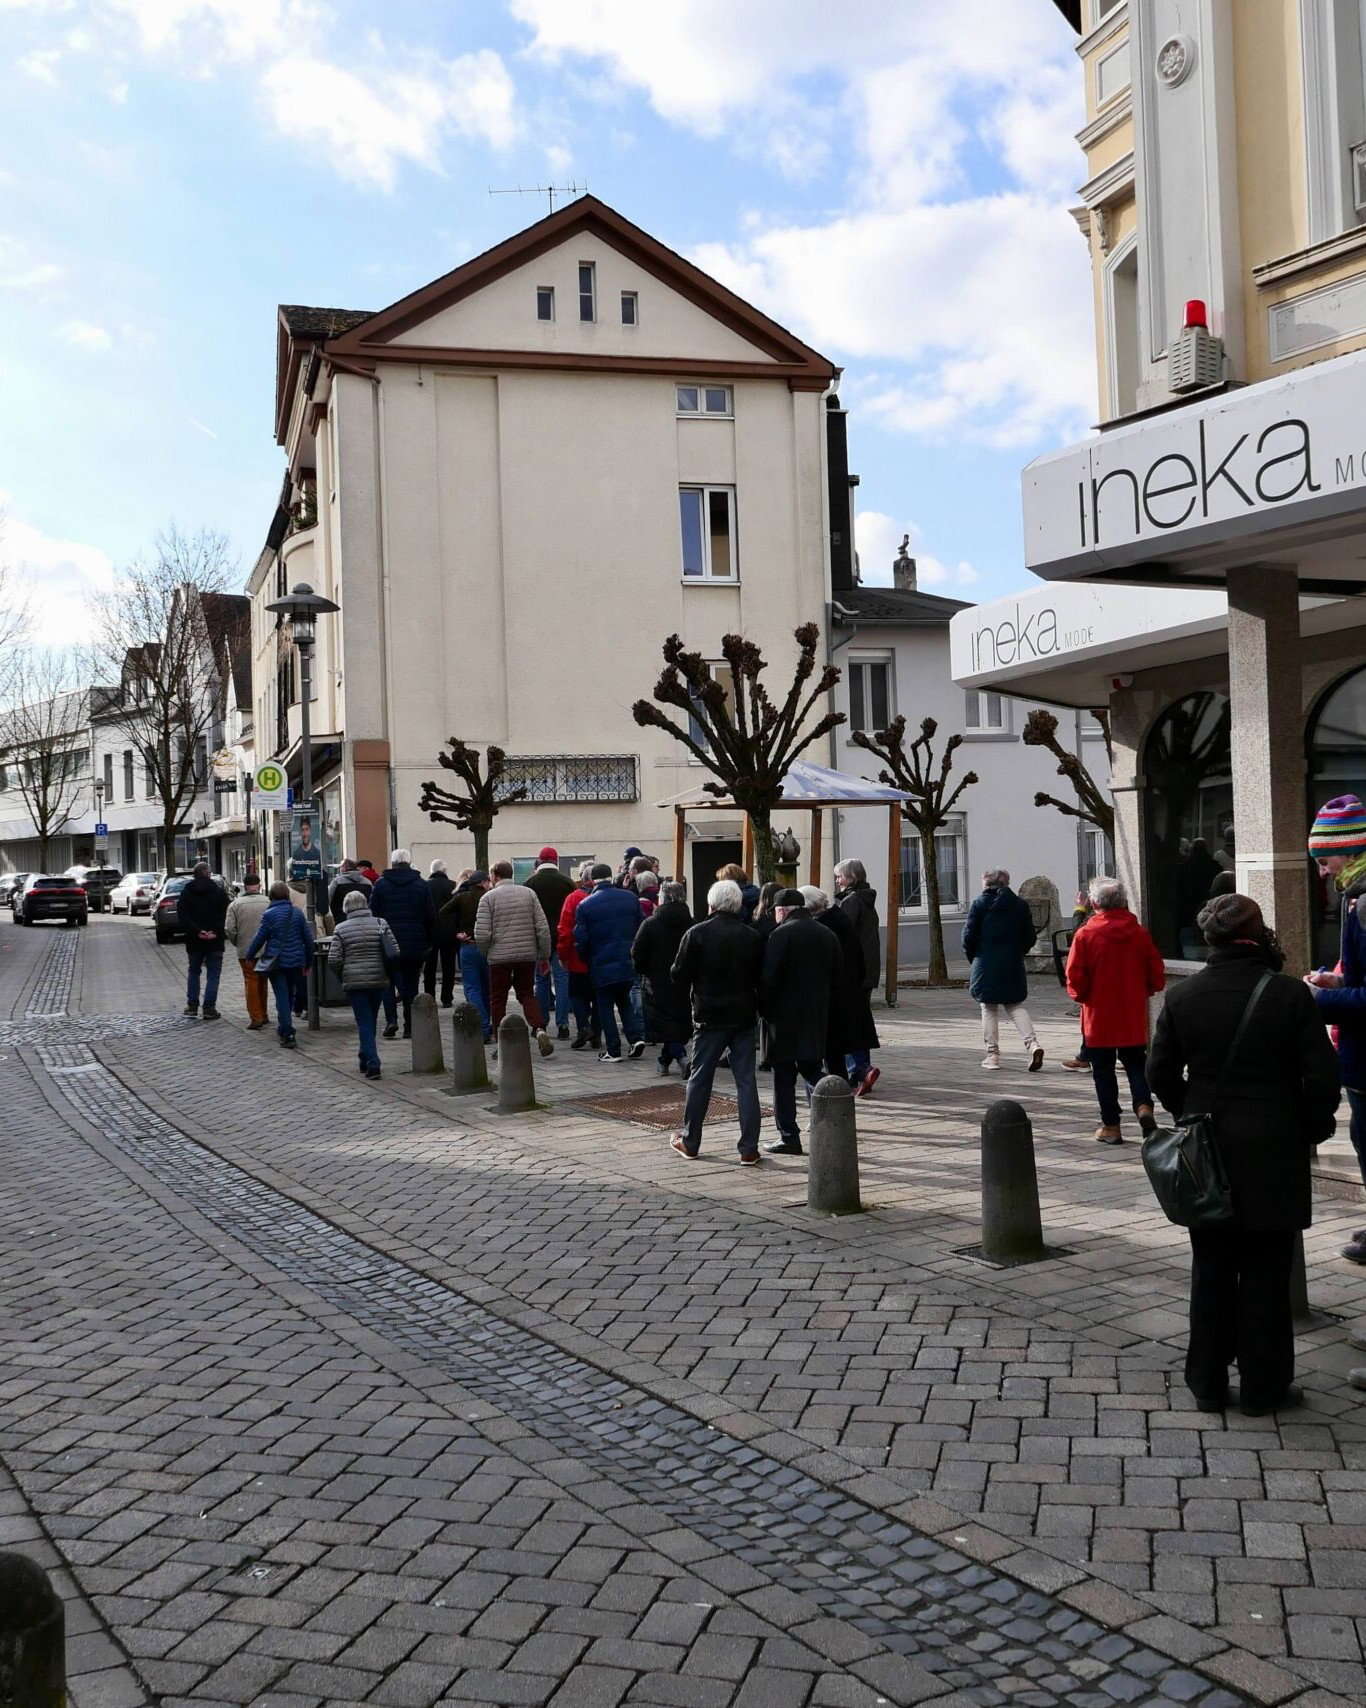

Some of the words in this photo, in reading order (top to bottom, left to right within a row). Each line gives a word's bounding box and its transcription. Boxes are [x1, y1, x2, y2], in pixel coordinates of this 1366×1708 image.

[1079, 418, 1321, 547] ineka
[971, 604, 1061, 672] ineka
[1064, 627, 1095, 647] MODE
[264, 772, 276, 786] H
[98, 825, 105, 835] P
